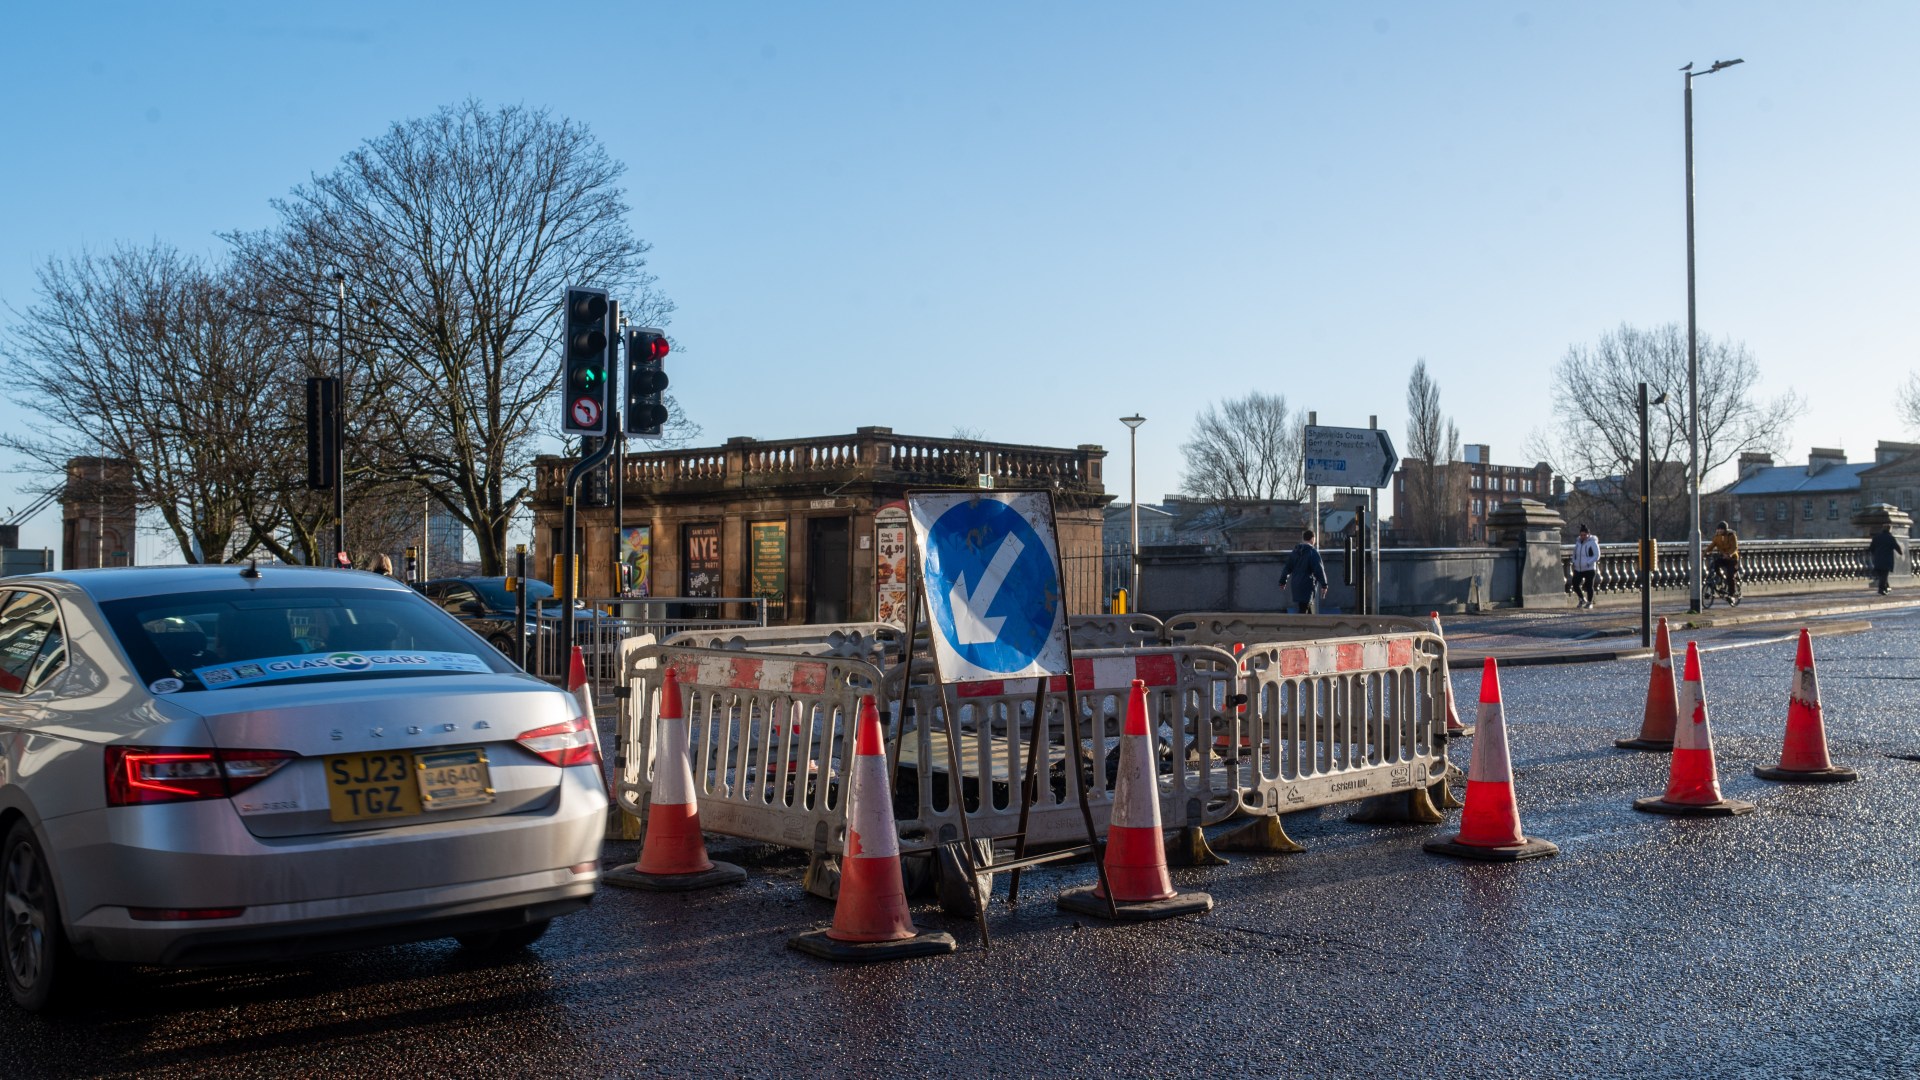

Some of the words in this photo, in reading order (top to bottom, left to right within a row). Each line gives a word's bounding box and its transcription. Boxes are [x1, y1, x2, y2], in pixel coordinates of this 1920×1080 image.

[1335, 440, 1355, 449] Cross
[1345, 432, 1364, 441] Cross
[690, 537, 719, 560] NYE
[881, 545, 904, 558] £4.99
[370, 655, 427, 664] CARS
[332, 755, 407, 784] SJ23
[436, 766, 480, 786] 4640
[346, 787, 403, 815] TGZ
